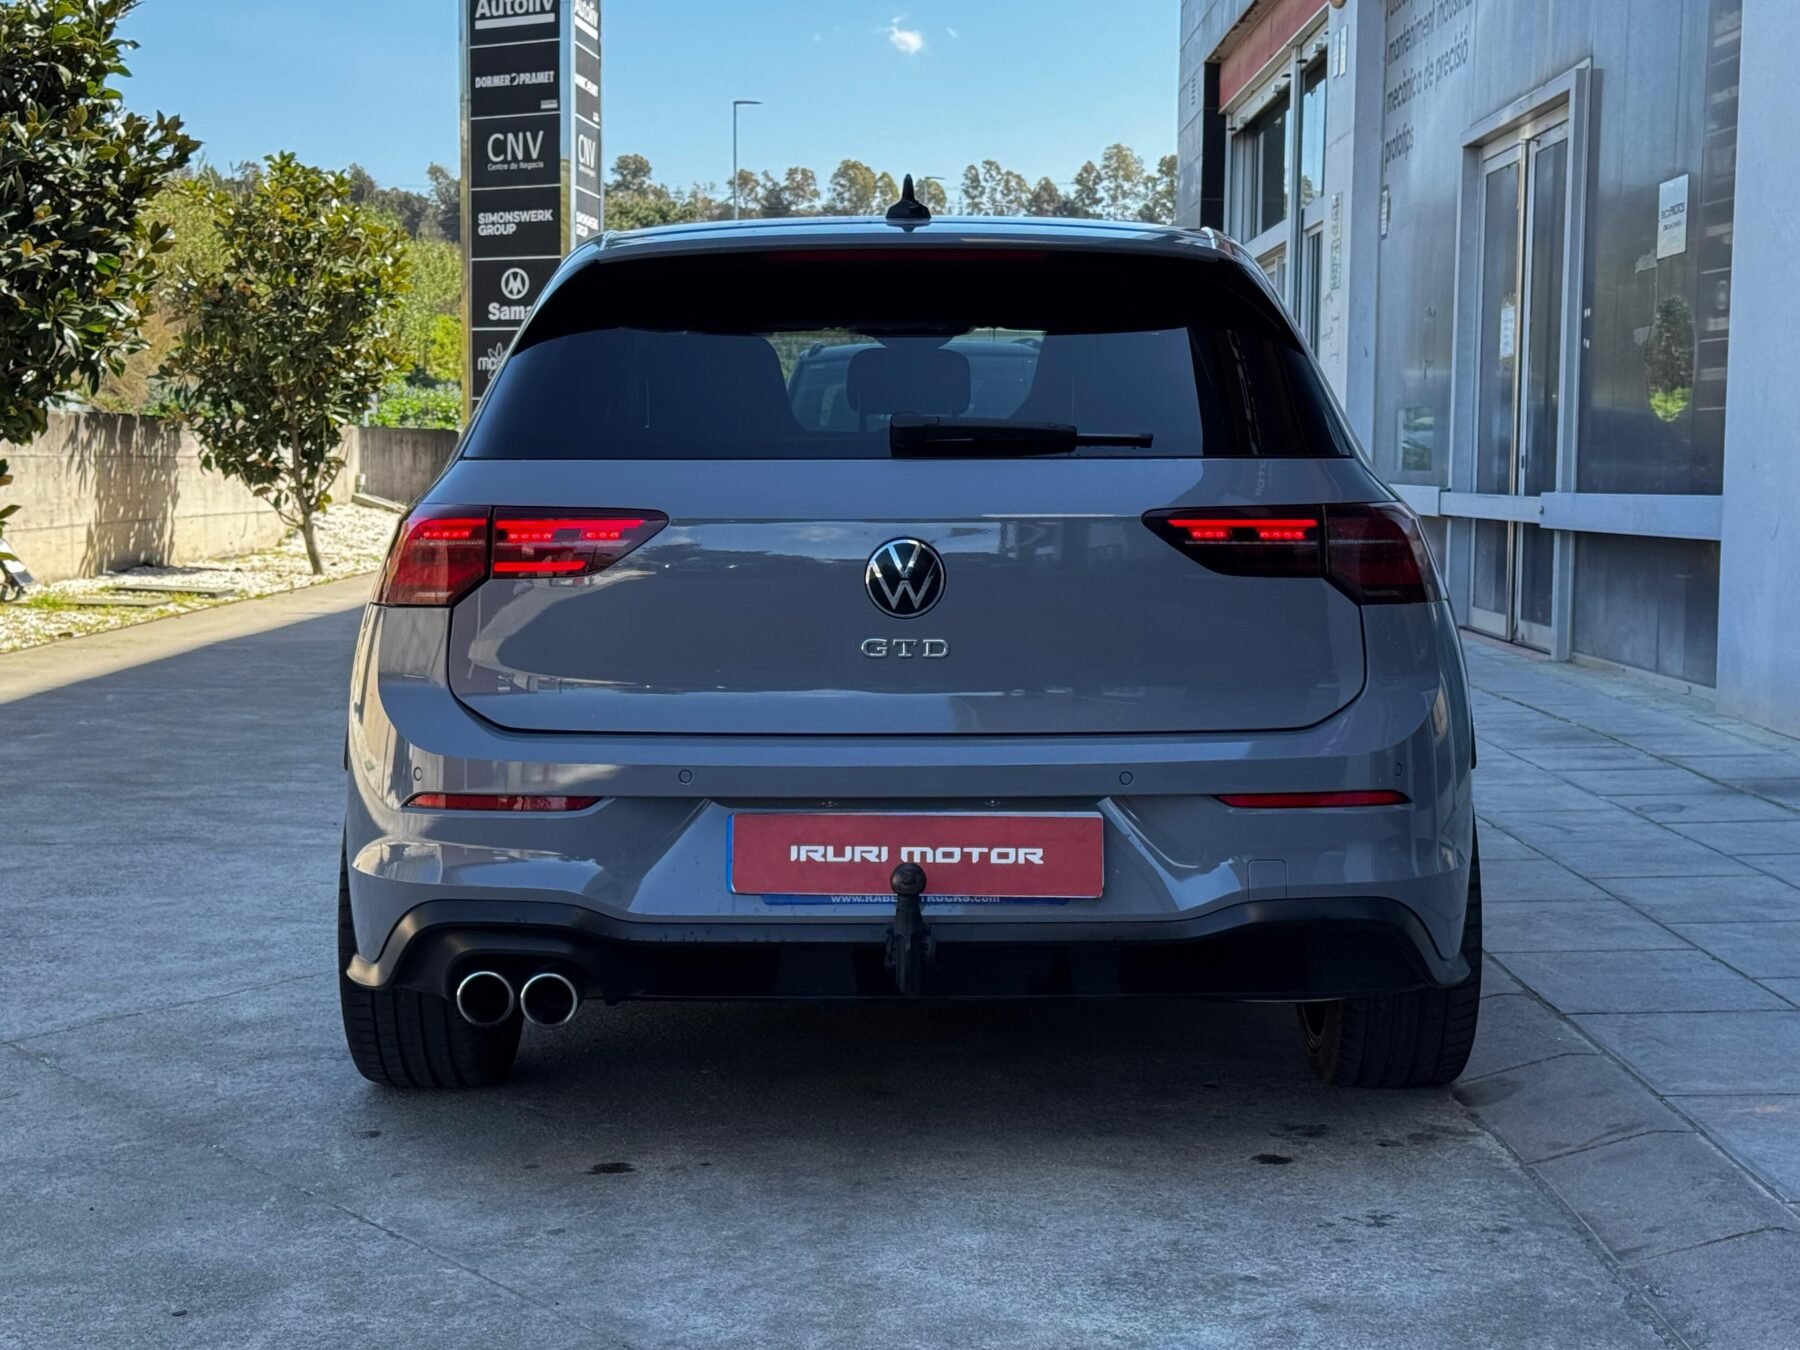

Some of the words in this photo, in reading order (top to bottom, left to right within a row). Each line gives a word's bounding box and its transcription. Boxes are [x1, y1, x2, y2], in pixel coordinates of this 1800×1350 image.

[475, 74, 511, 89] DORMER
[519, 71, 555, 85] PRAMET
[487, 130, 544, 162] CNV
[578, 134, 596, 169] CNV
[478, 209, 553, 224] SIMONSWERK
[478, 224, 517, 237] GROUP
[861, 638, 949, 658] GTD
[790, 844, 888, 862] IRURI
[901, 846, 1044, 865] MOTOR
